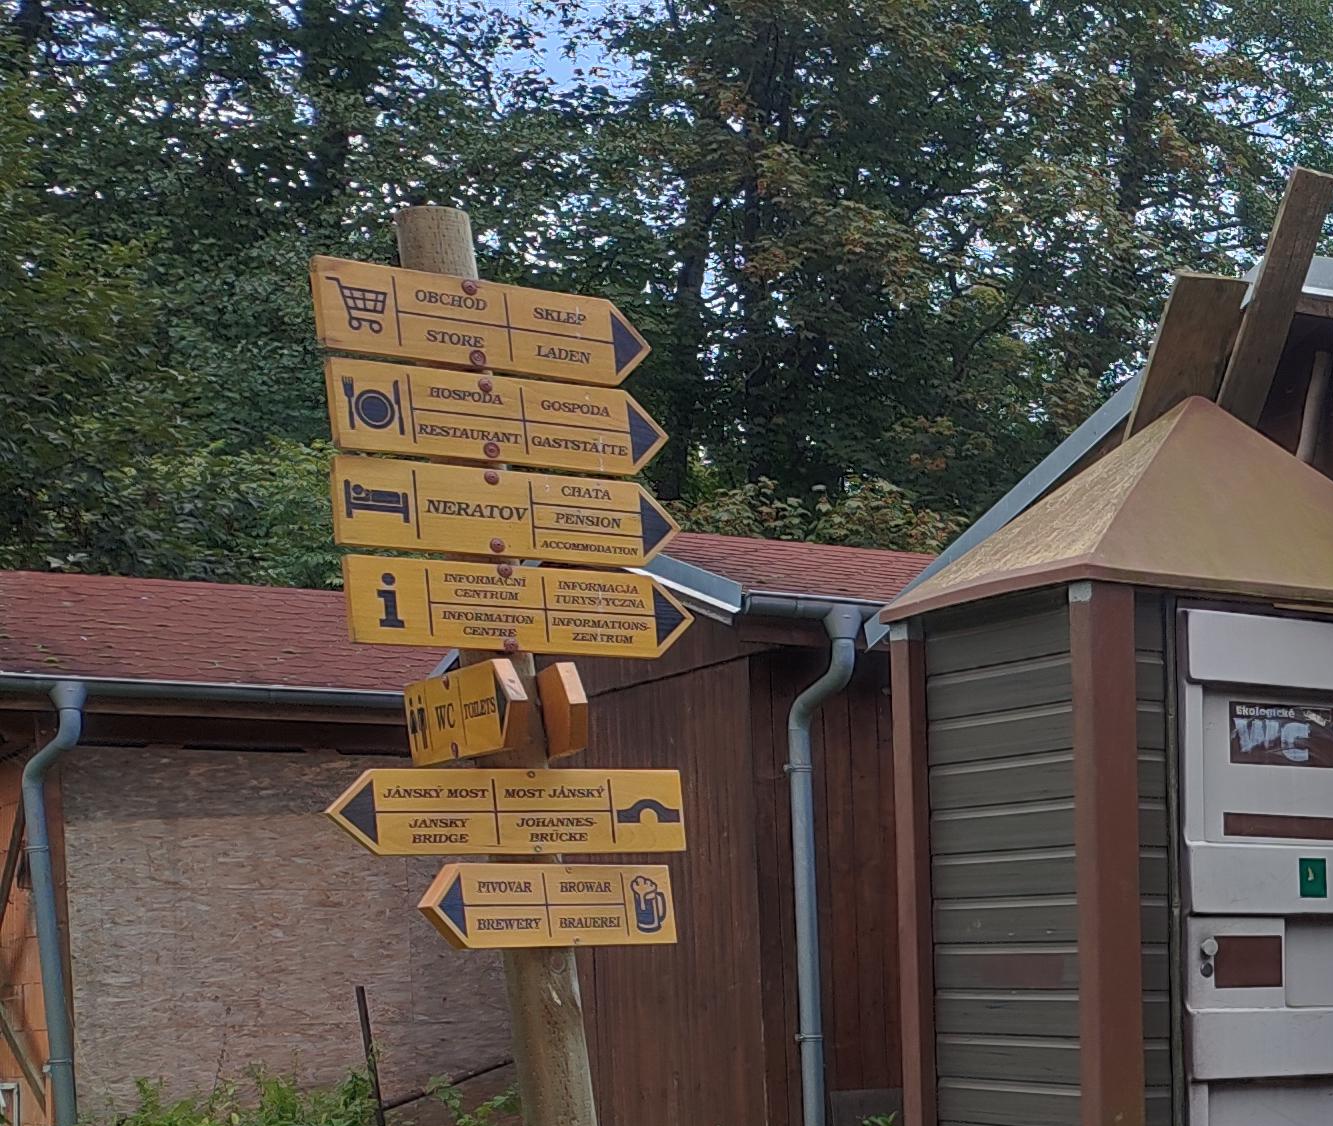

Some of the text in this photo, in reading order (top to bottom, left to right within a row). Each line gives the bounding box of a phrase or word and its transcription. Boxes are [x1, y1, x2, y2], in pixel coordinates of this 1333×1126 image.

[415, 289, 488, 311] OBCHOD
[533, 306, 586, 326] SKLEP
[426, 329, 485, 348] STORE
[536, 344, 592, 364] LADEN
[429, 386, 504, 405] HOSPODA
[540, 399, 611, 417] GOSPODA
[417, 423, 522, 444] RESTAURANT
[560, 485, 612, 501] CHATA
[426, 499, 529, 521] NERATOV
[554, 512, 622, 529] PENSION
[540, 540, 639, 556] ACCOMMODATION
[454, 588, 519, 600] CENTRUM
[557, 580, 640, 594] INFORMACJA
[554, 594, 645, 609] TURYSTYCZNA
[442, 610, 535, 625] INFORMATION
[551, 616, 652, 631] INFORMATIONS-
[463, 626, 517, 638] CENTRE
[571, 632, 633, 644] ZENTRUM
[435, 703, 456, 729] WC
[463, 697, 496, 720] TOILETS
[1236, 705, 1295, 718] Ekologické
[1232, 717, 1310, 761] WC
[447, 788, 489, 799] MOST
[504, 788, 545, 799] MOST
[516, 817, 597, 828] JOHANNES-
[412, 833, 469, 844] BRIDGE
[529, 829, 588, 843] BRÜCKE
[477, 881, 533, 893] PIVOVAR
[560, 881, 612, 893] BROWAR
[477, 917, 541, 930] BREWERY
[559, 916, 621, 929] BRAUEREI
